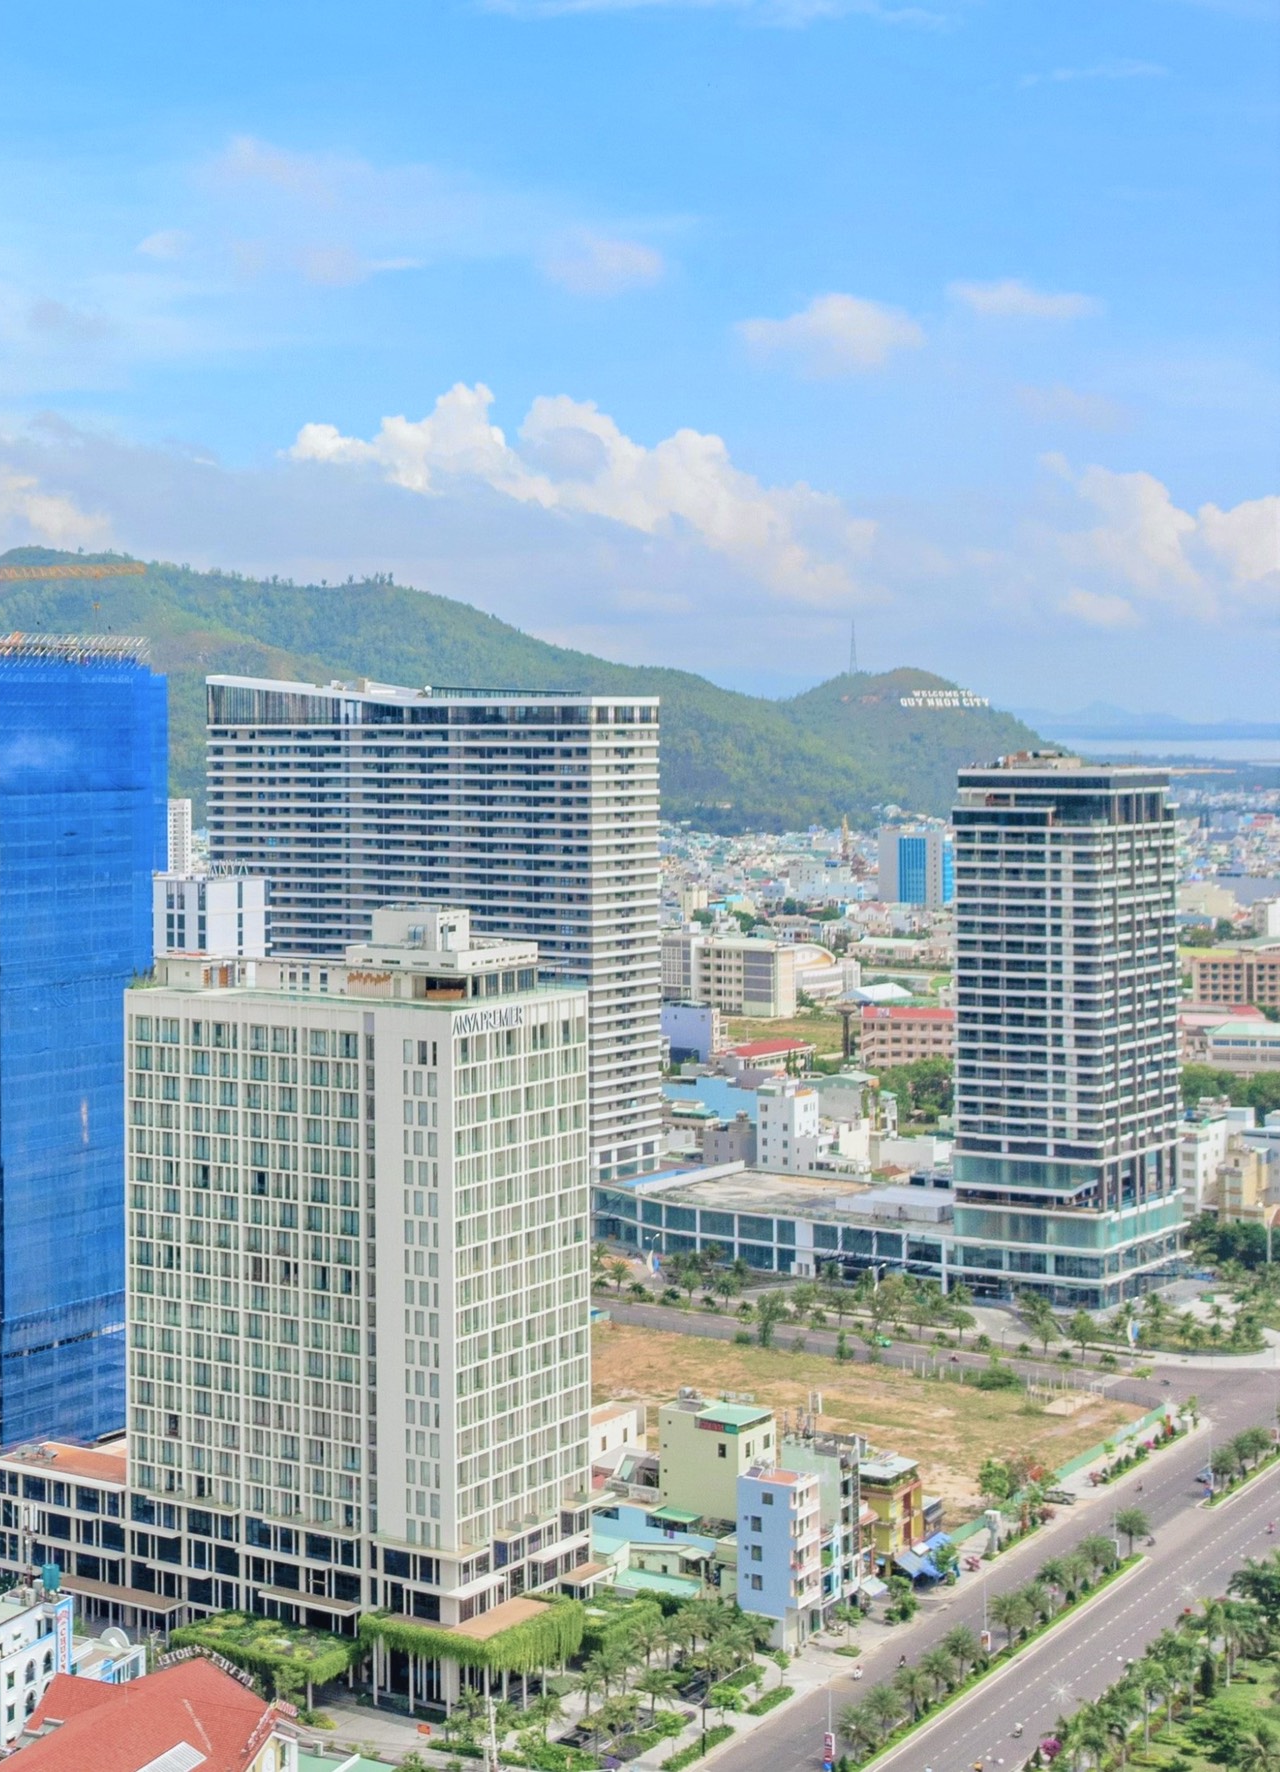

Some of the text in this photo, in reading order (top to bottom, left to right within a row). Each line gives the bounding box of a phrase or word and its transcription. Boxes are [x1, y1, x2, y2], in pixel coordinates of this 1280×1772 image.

[912, 690, 959, 698] WELCOME
[900, 697, 924, 707] QUY
[962, 697, 990, 707] CITY
[207, 858, 249, 878] ANYA
[452, 1012, 480, 1036] ANYA
